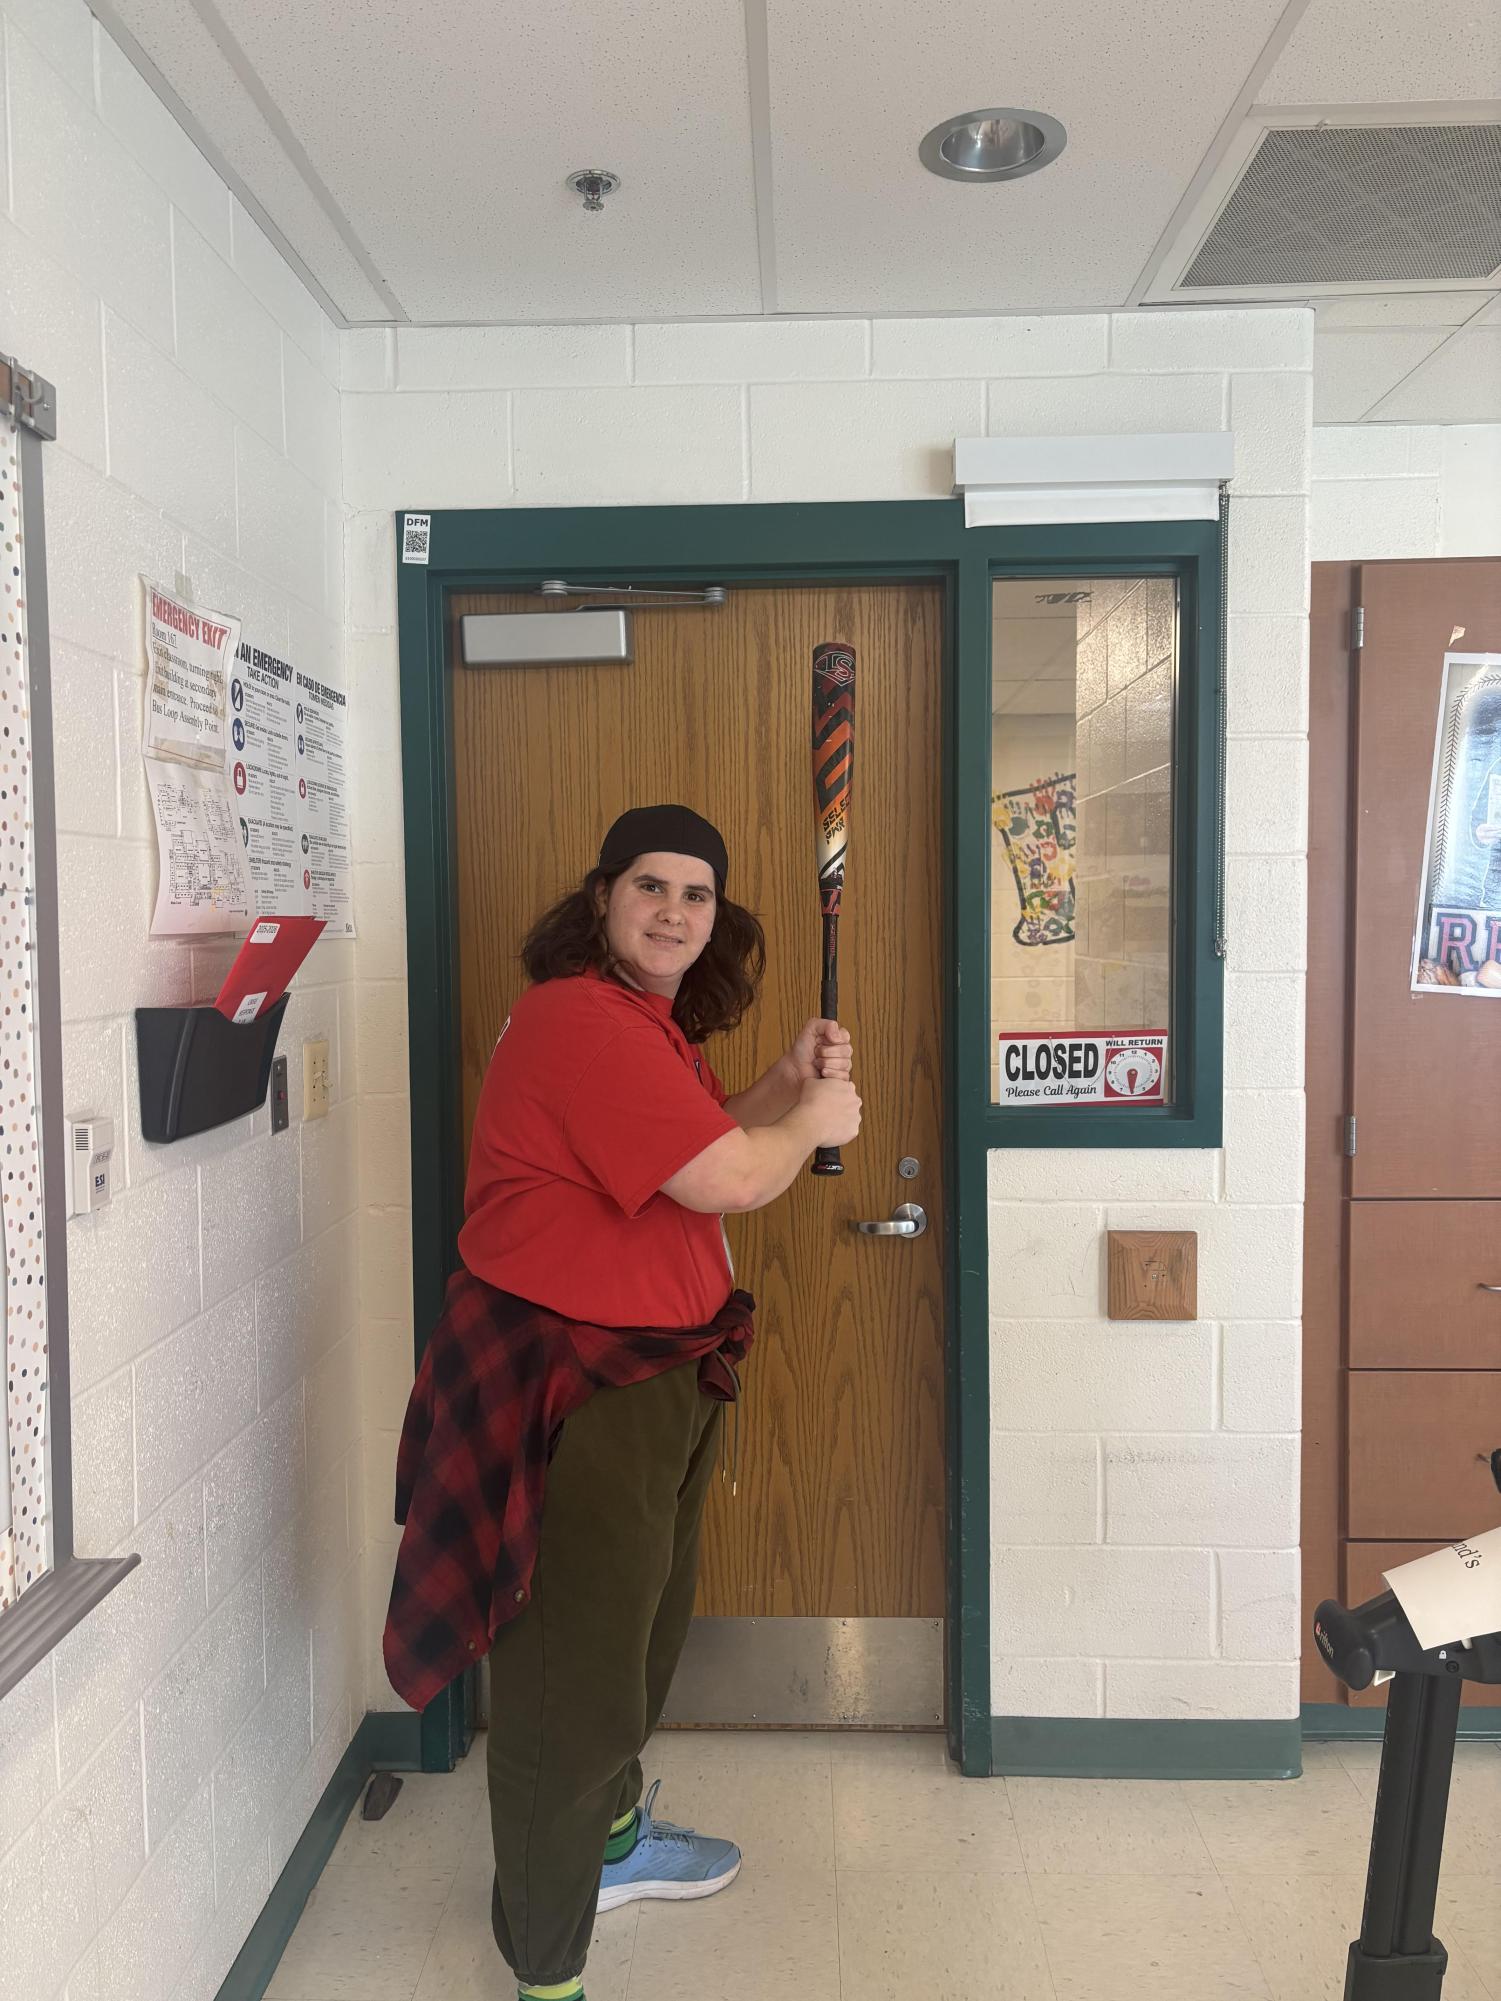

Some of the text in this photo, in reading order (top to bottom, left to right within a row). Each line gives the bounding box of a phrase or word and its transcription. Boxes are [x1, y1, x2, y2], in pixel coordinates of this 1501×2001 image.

[406, 518, 429, 527] DFM
[152, 591, 228, 651] EMERGENCY EXIT
[152, 622, 167, 641] Room
[240, 642, 251, 664] AN
[252, 647, 293, 683] EMERGENCY
[247, 666, 279, 690] TAKE ACTION
[296, 672, 302, 687] EN
[303, 675, 314, 692] CASO
[152, 699, 163, 714] Bus
[163, 703, 178, 723] Loop
[1128, 1038, 1163, 1046] RETURN
[1005, 1043, 1099, 1082] CLOSED
[1005, 1084, 1097, 1099] Please Call Again
[95, 1173, 105, 1188] ESI
